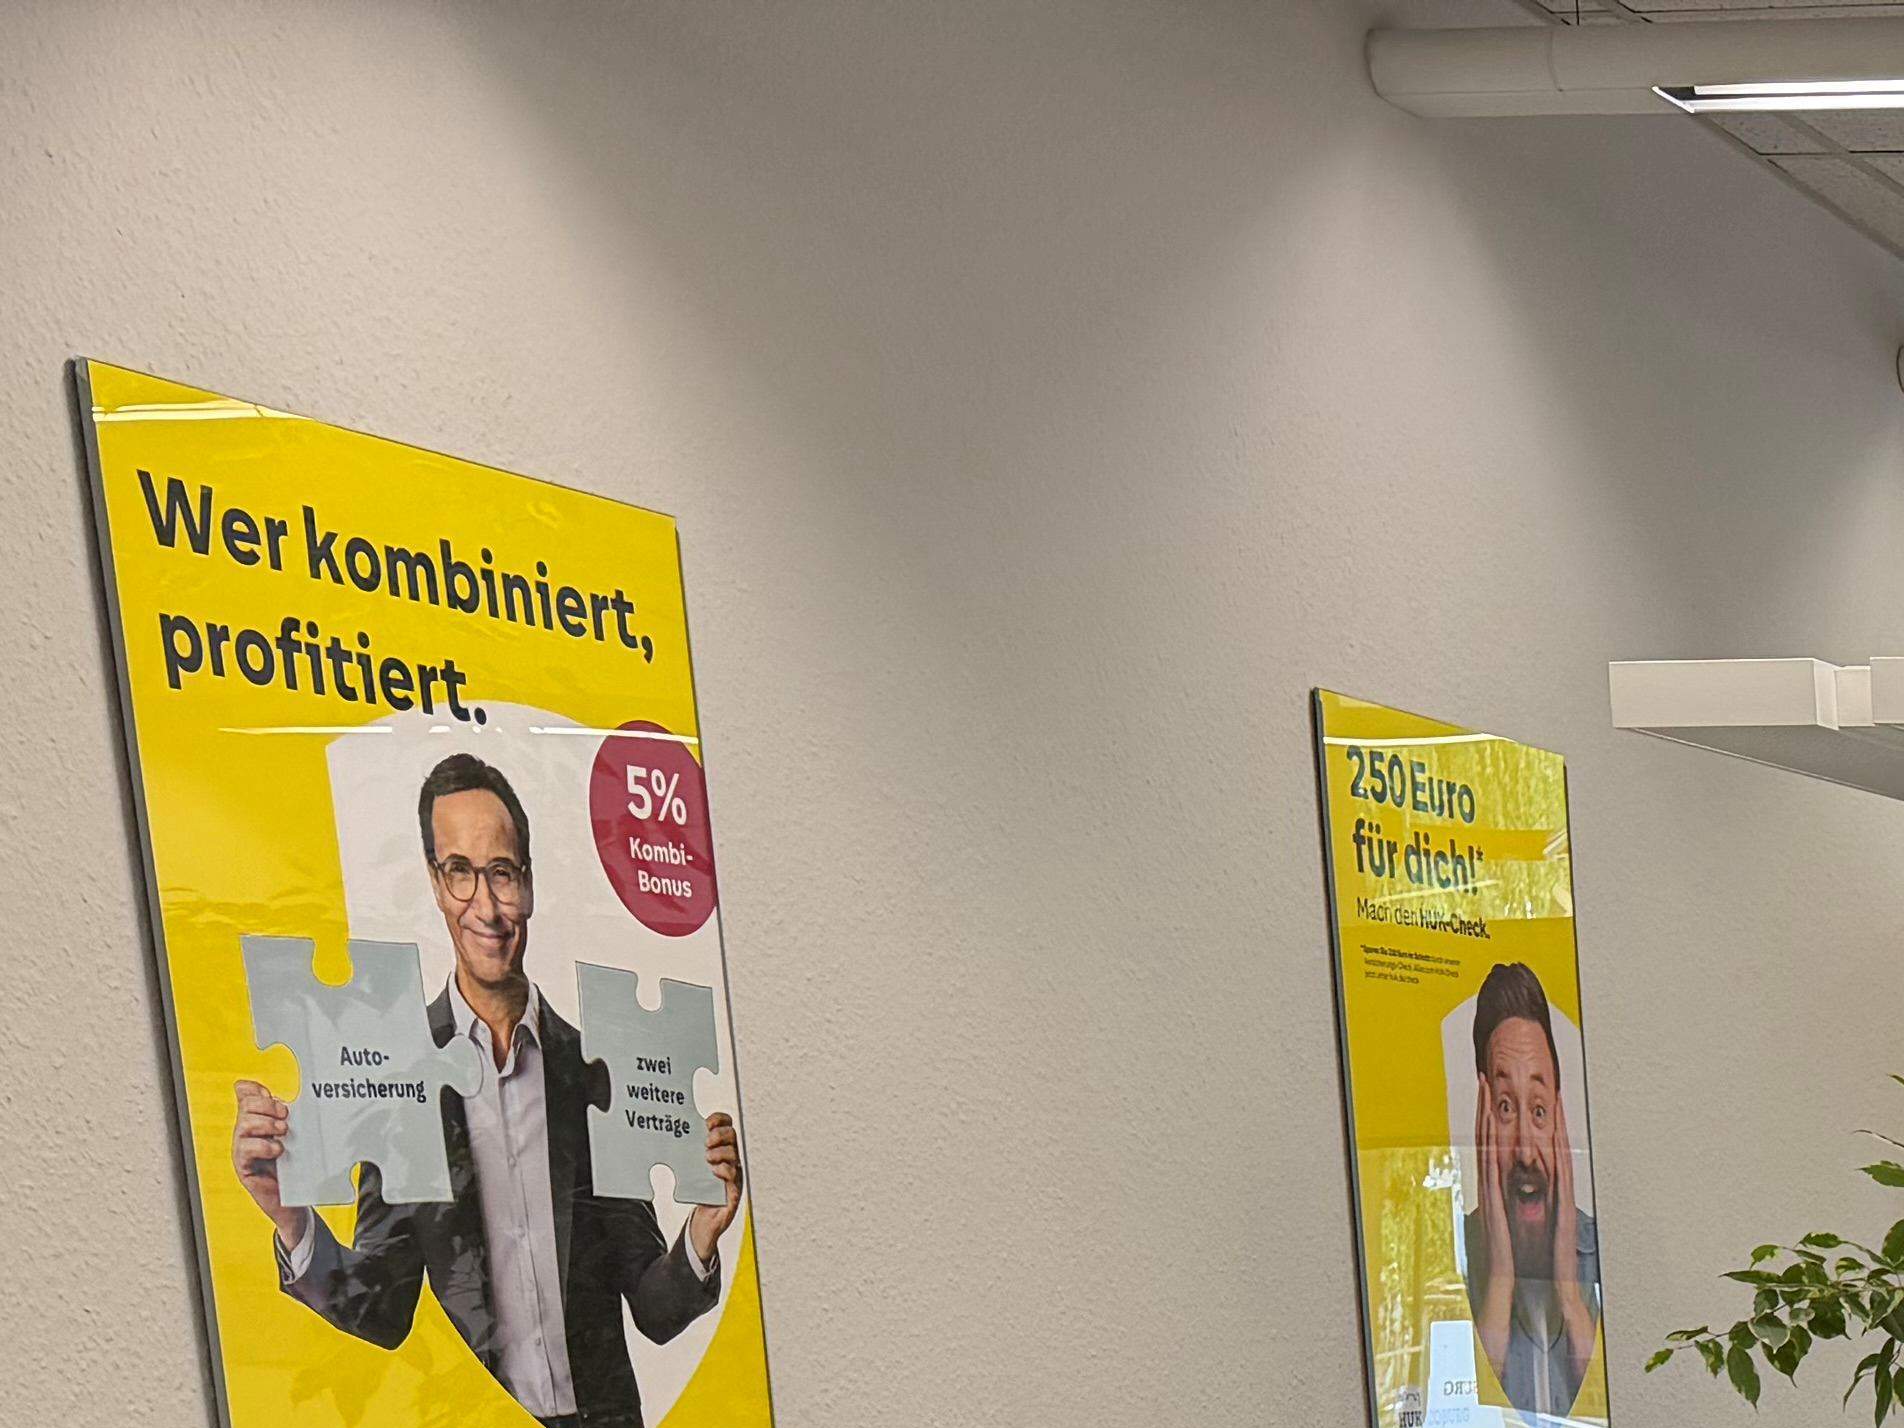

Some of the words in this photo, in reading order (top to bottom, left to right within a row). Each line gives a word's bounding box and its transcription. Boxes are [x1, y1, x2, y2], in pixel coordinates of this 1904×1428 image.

[136, 468, 289, 571] Wer
[302, 504, 656, 663] kombiniert,
[158, 609, 488, 727] profitiert.
[626, 763, 688, 827] 5%
[1346, 745, 1406, 808] 250
[1410, 759, 1476, 824] Euro
[629, 834, 694, 869] Kombi-
[1352, 816, 1398, 880] für
[638, 868, 693, 898] Bonus
[1357, 897, 1392, 924] Mach
[1419, 907, 1491, 941] HUK-Check.
[339, 1043, 390, 1068] Auto-
[636, 1053, 672, 1076] zwei
[311, 1075, 427, 1103] versicherung
[626, 1080, 685, 1106] weitere
[625, 1107, 691, 1138] Verträge
[1398, 1411, 1422, 1428] HUK
